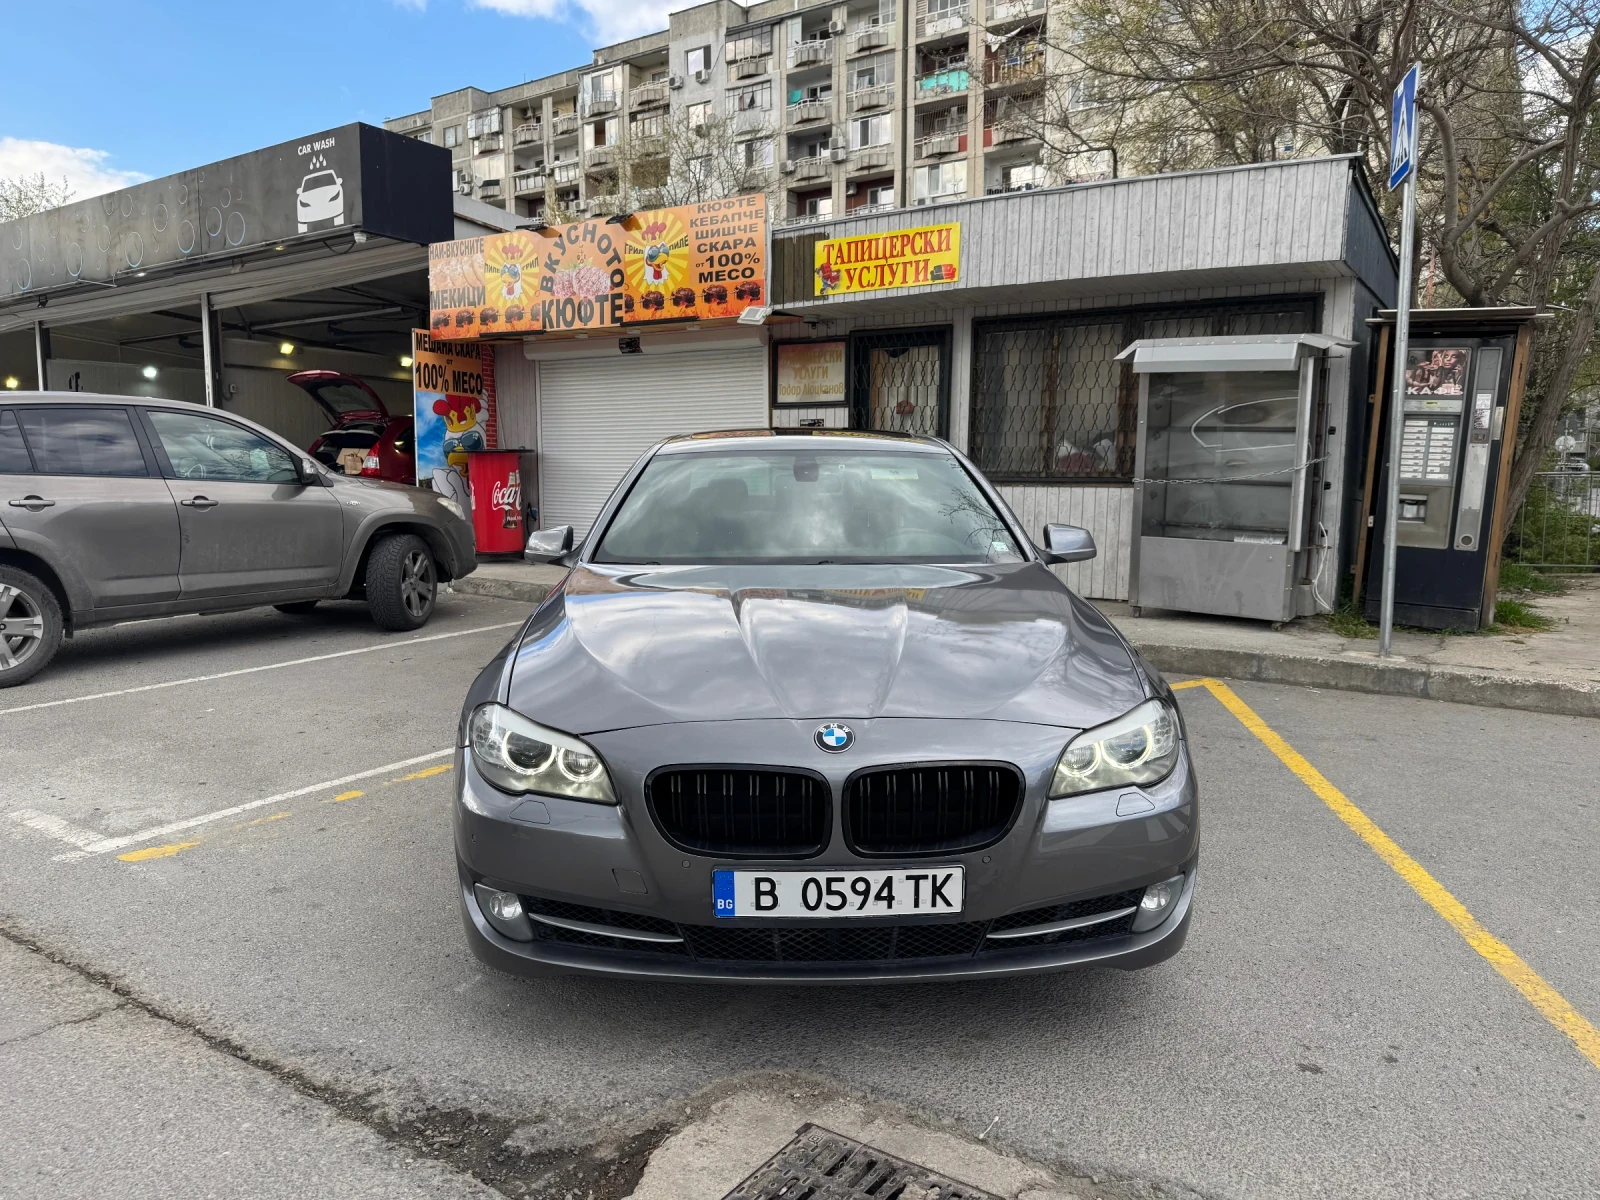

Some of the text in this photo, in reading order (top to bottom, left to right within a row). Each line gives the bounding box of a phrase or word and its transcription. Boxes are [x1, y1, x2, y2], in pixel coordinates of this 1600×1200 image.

[297, 137, 335, 156] CAR WASH
[697, 196, 757, 214] КЮФТЕ
[690, 208, 764, 228] КЕБАПЧЕ
[695, 222, 758, 240] ШИШЧЕ
[668, 234, 689, 251] ПИЛЕ
[696, 236, 757, 254] СКАРА
[822, 227, 952, 266] ТАПИЦЕРСКИ
[540, 222, 624, 293] ВКУСНОТО
[705, 252, 761, 269] 100%
[698, 267, 755, 284] МЕСО
[844, 258, 931, 290] УСЛУГИ
[430, 286, 486, 310] МЕКИЦИ
[541, 292, 624, 329] КЮФТЕ
[416, 332, 482, 360] МЕШАНА СКАРА
[416, 361, 483, 396] 100% МЕСО
[818, 722, 850, 733] BMW
[754, 873, 954, 911] B 0594 TK
[717, 898, 733, 909] BG
